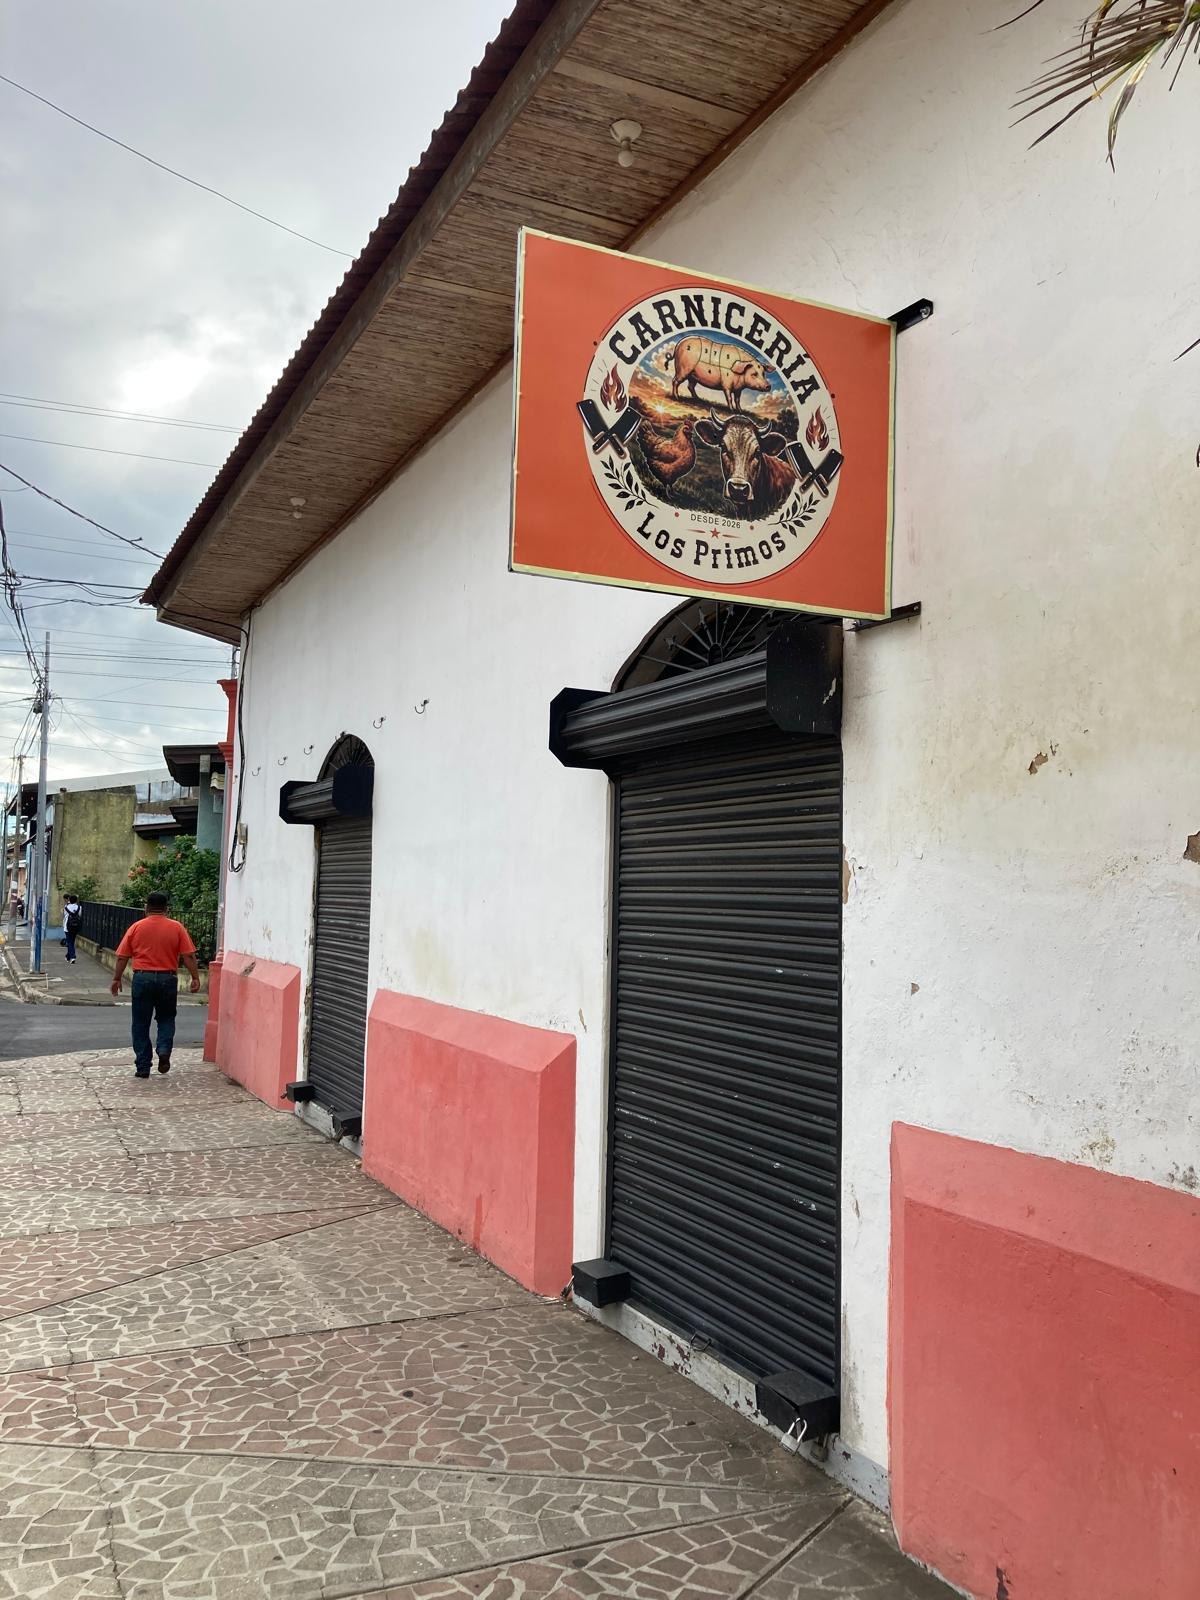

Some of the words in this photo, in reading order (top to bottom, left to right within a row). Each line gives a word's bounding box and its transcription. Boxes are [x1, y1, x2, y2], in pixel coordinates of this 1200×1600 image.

[609, 295, 821, 405] CARNICERÍA
[636, 511, 686, 558] Los
[693, 531, 786, 569] Primos
[690, 513, 719, 526] DESDE
[722, 519, 741, 529] 2026
